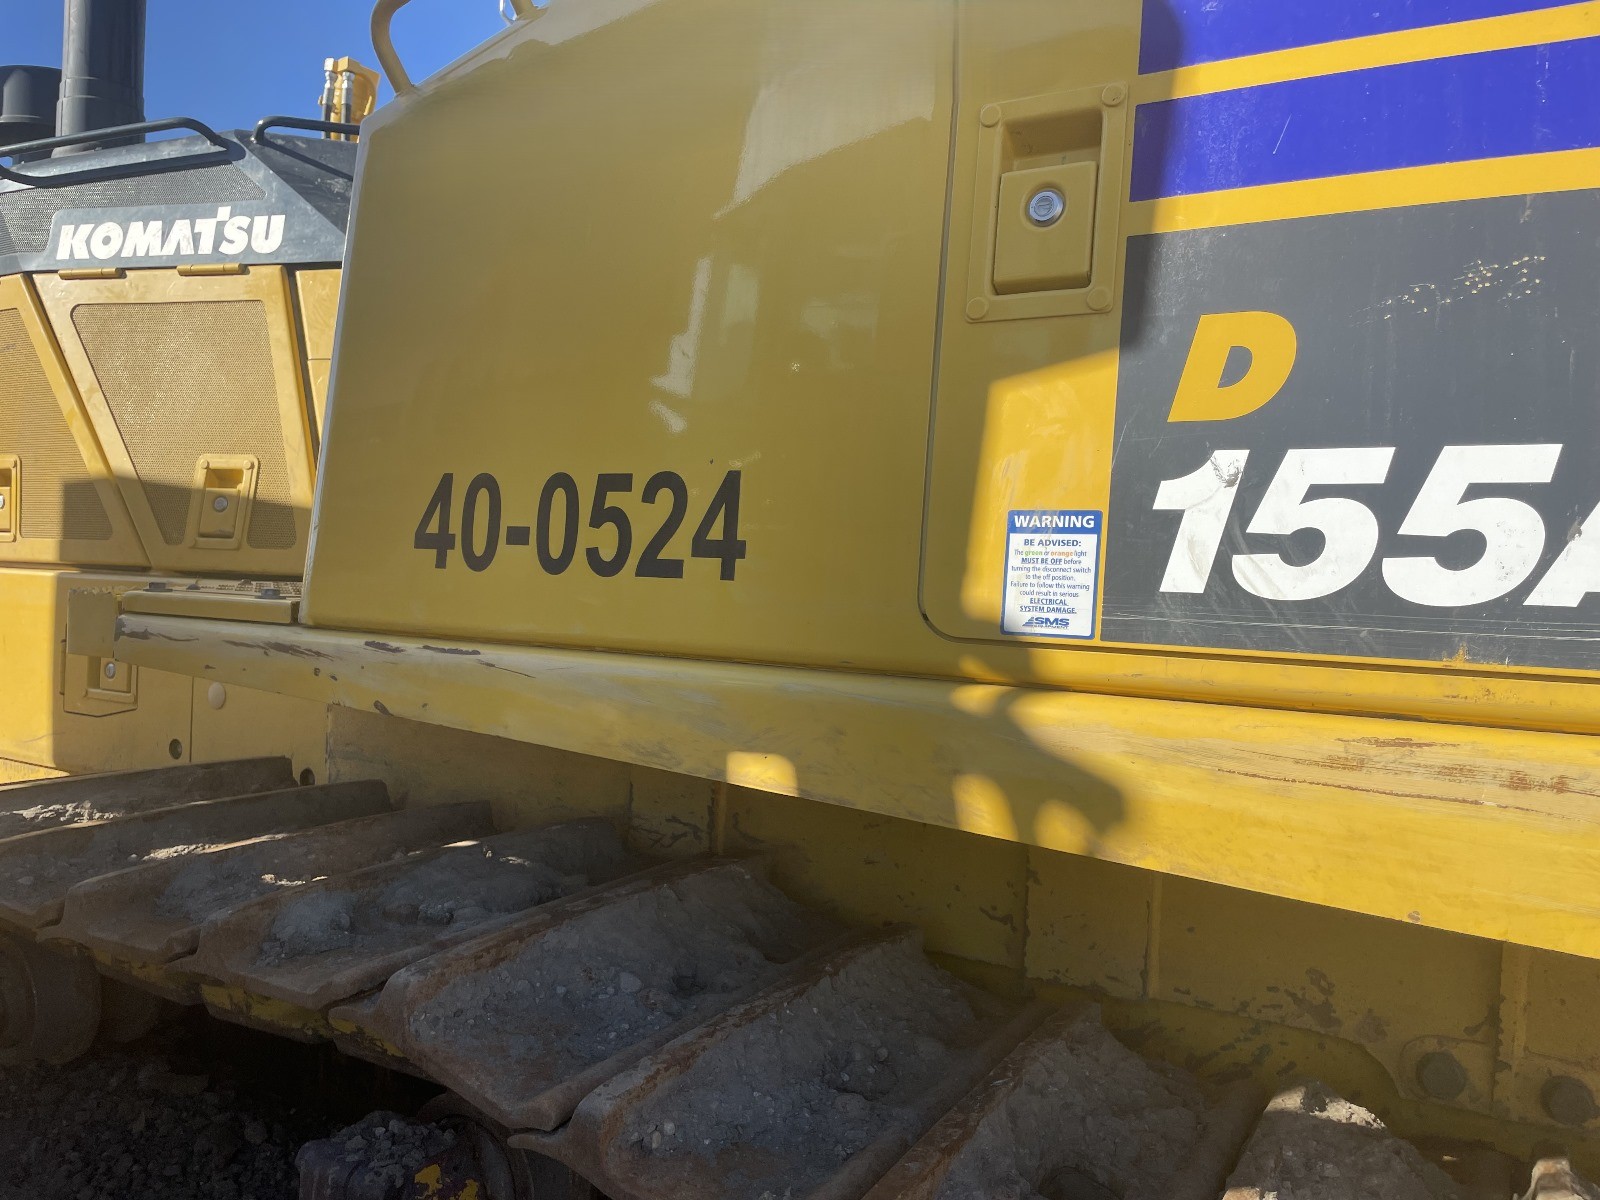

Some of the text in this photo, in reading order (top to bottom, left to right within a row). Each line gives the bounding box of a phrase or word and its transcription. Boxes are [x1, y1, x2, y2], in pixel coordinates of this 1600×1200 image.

[56, 205, 286, 260] KOMATSU
[1167, 310, 1297, 422] D
[413, 469, 747, 581] 40-0524
[1014, 515, 1095, 528] WARNING
[1038, 539, 1082, 547] ADVISED:
[1066, 583, 1090, 591] warning
[1030, 598, 1068, 606] ELECTRICAL
[1034, 616, 1070, 626] SMS
